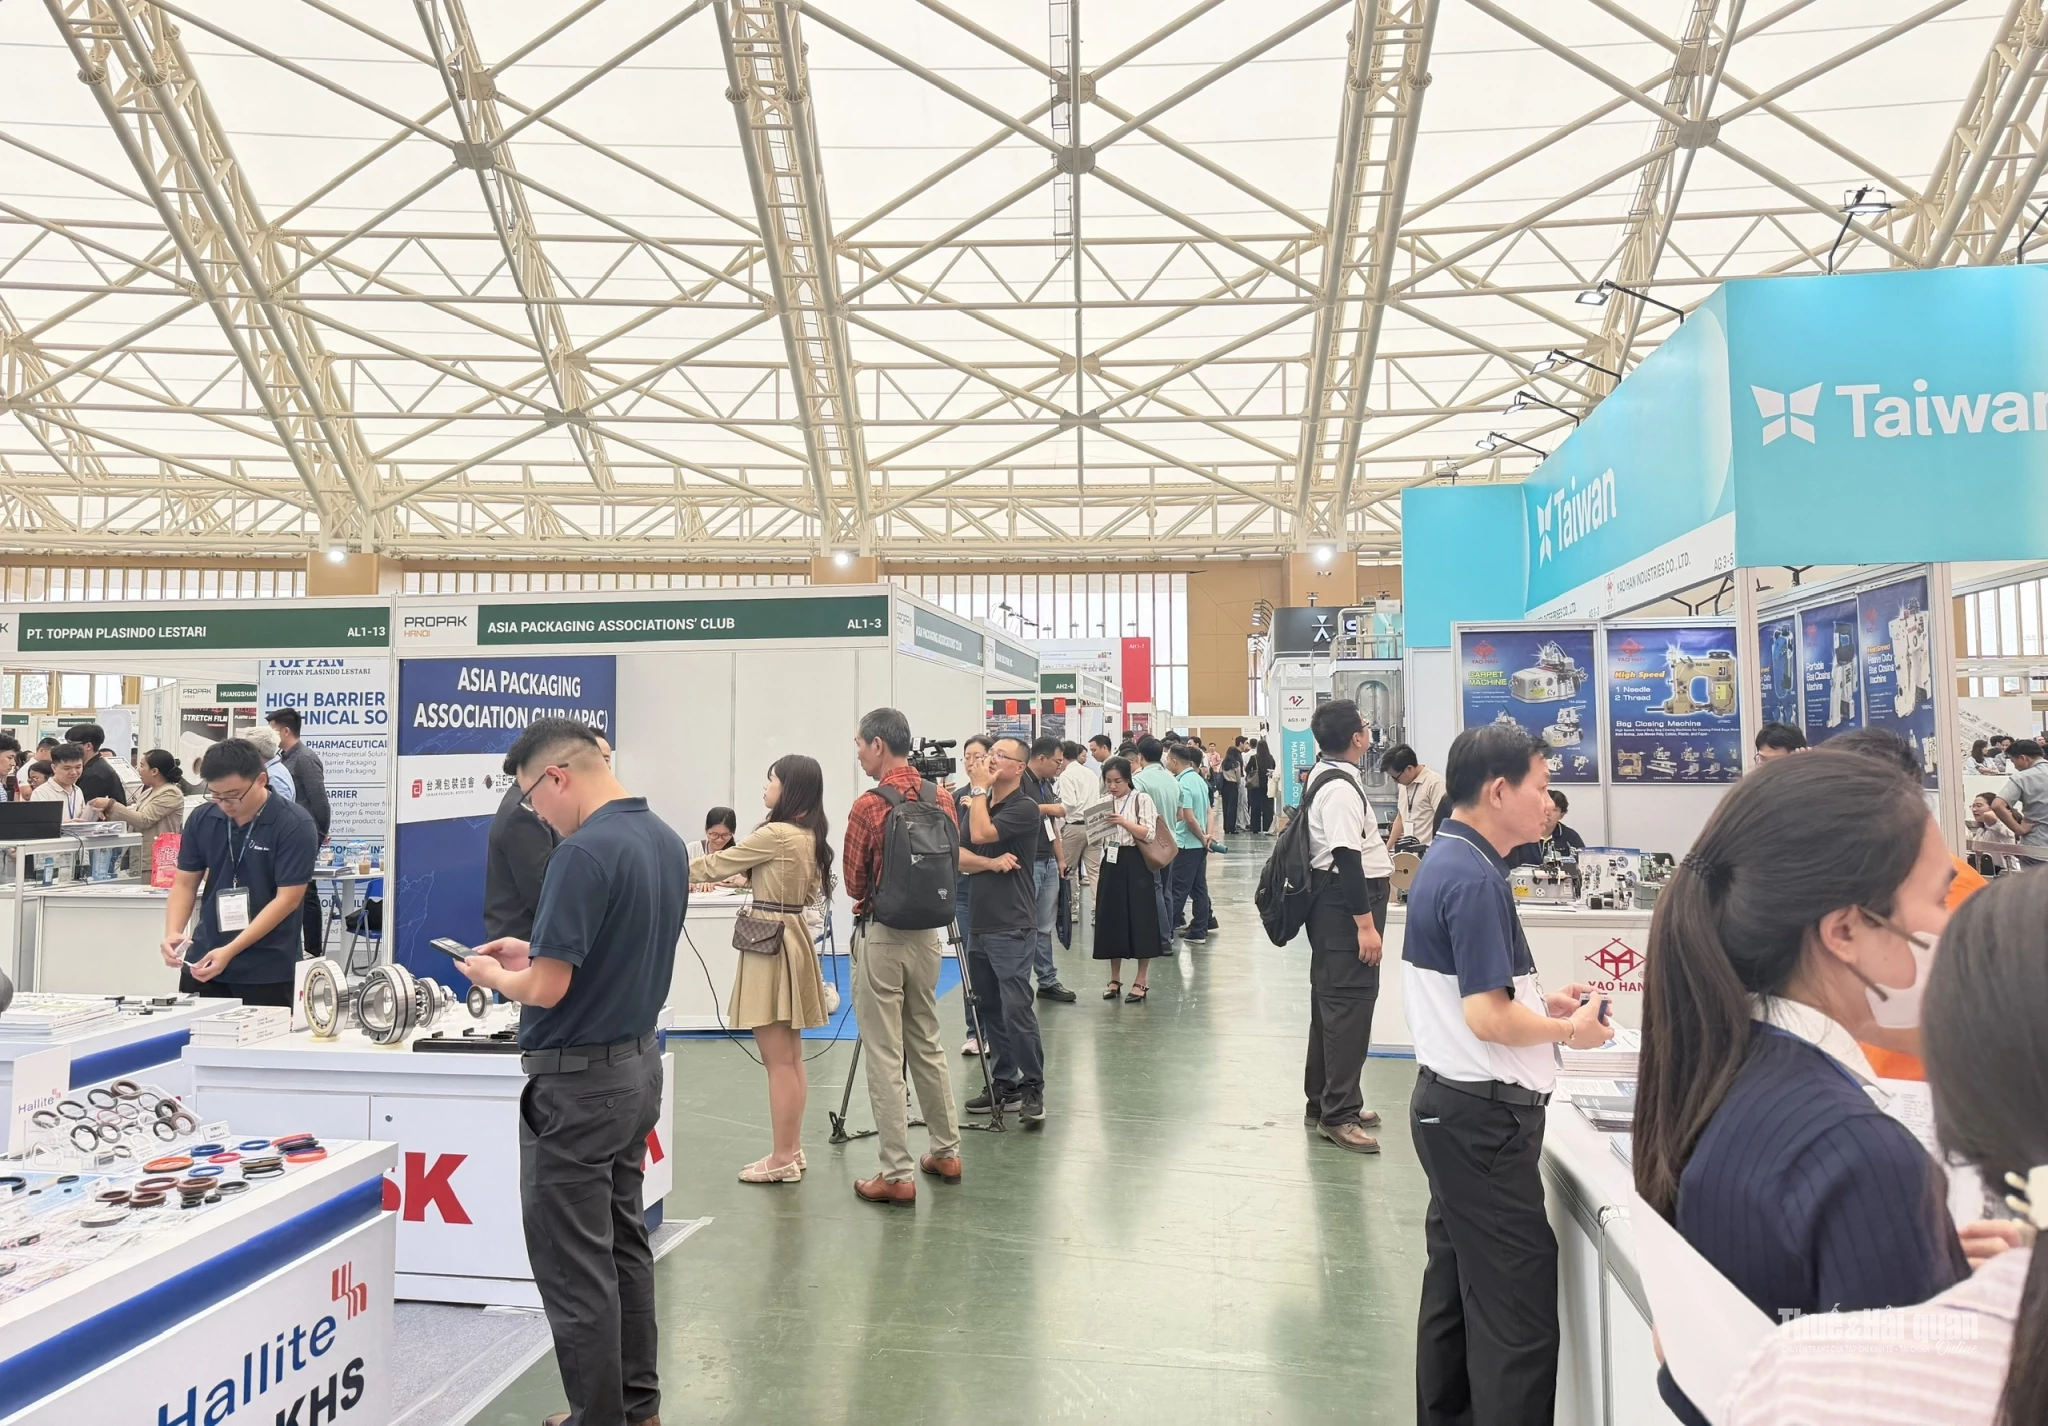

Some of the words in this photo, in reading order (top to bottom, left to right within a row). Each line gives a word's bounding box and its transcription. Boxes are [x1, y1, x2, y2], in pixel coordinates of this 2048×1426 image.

[1554, 467, 1617, 552] Taiwan
[1636, 565, 1664, 586] INDUSTRIES
[1678, 552, 1691, 571] LTD.
[1714, 558, 1722, 572] AG
[404, 616, 468, 628] PROPAK
[488, 622, 518, 634] ASIA
[520, 620, 594, 632] PACKAGING
[598, 618, 698, 632] ASSOCIATIONS’
[700, 618, 736, 630] CLUB
[847, 618, 882, 630] AL1-3
[26, 628, 44, 640] PT.
[46, 628, 93, 640] TOPPAN
[96, 627, 156, 640] PLASINDO
[158, 626, 206, 638] LESTARI
[348, 626, 386, 638] AL1-13
[404, 630, 430, 638] HANOI
[457, 666, 497, 693] ASIA
[500, 669, 581, 698] PACKAGING
[1614, 671, 1636, 679] High
[1638, 671, 1665, 679] Speed
[1807, 682, 1823, 691] Machine
[266, 692, 308, 707] HIGH
[314, 692, 386, 706] BARRIER
[266, 710, 360, 724] HNICAL
[413, 702, 528, 728] ASSOCIATION
[1588, 981, 1614, 992] YAO
[1620, 982, 1645, 992] HAN
[18, 1096, 54, 1114] Hallite
[158, 1316, 336, 1426] Hallite
[276, 1357, 364, 1426] KHS
